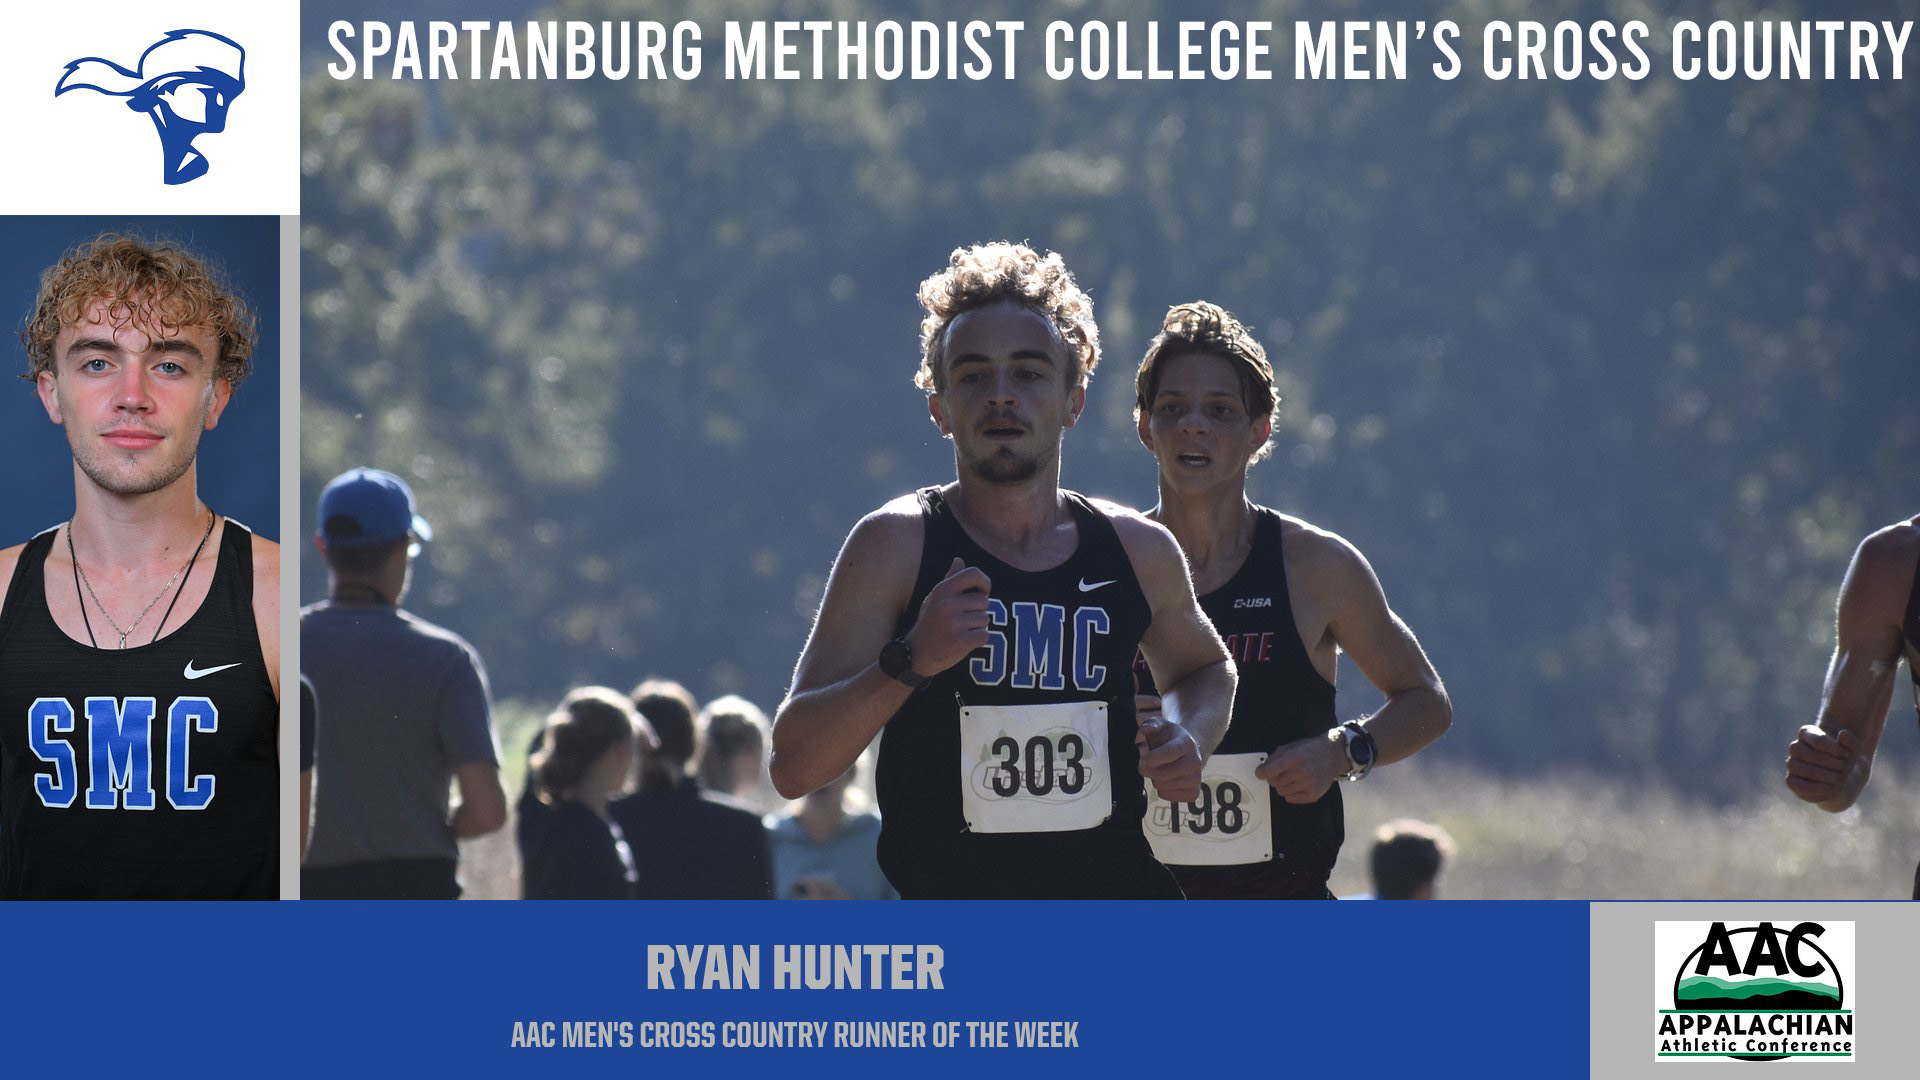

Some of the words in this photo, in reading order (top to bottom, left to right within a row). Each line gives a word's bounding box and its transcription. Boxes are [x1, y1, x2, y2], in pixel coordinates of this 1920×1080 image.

[969, 598, 1110, 692] SMC
[27, 695, 219, 811] SMC
[991, 733, 1085, 798] 303
[1170, 781, 1244, 835] 198
